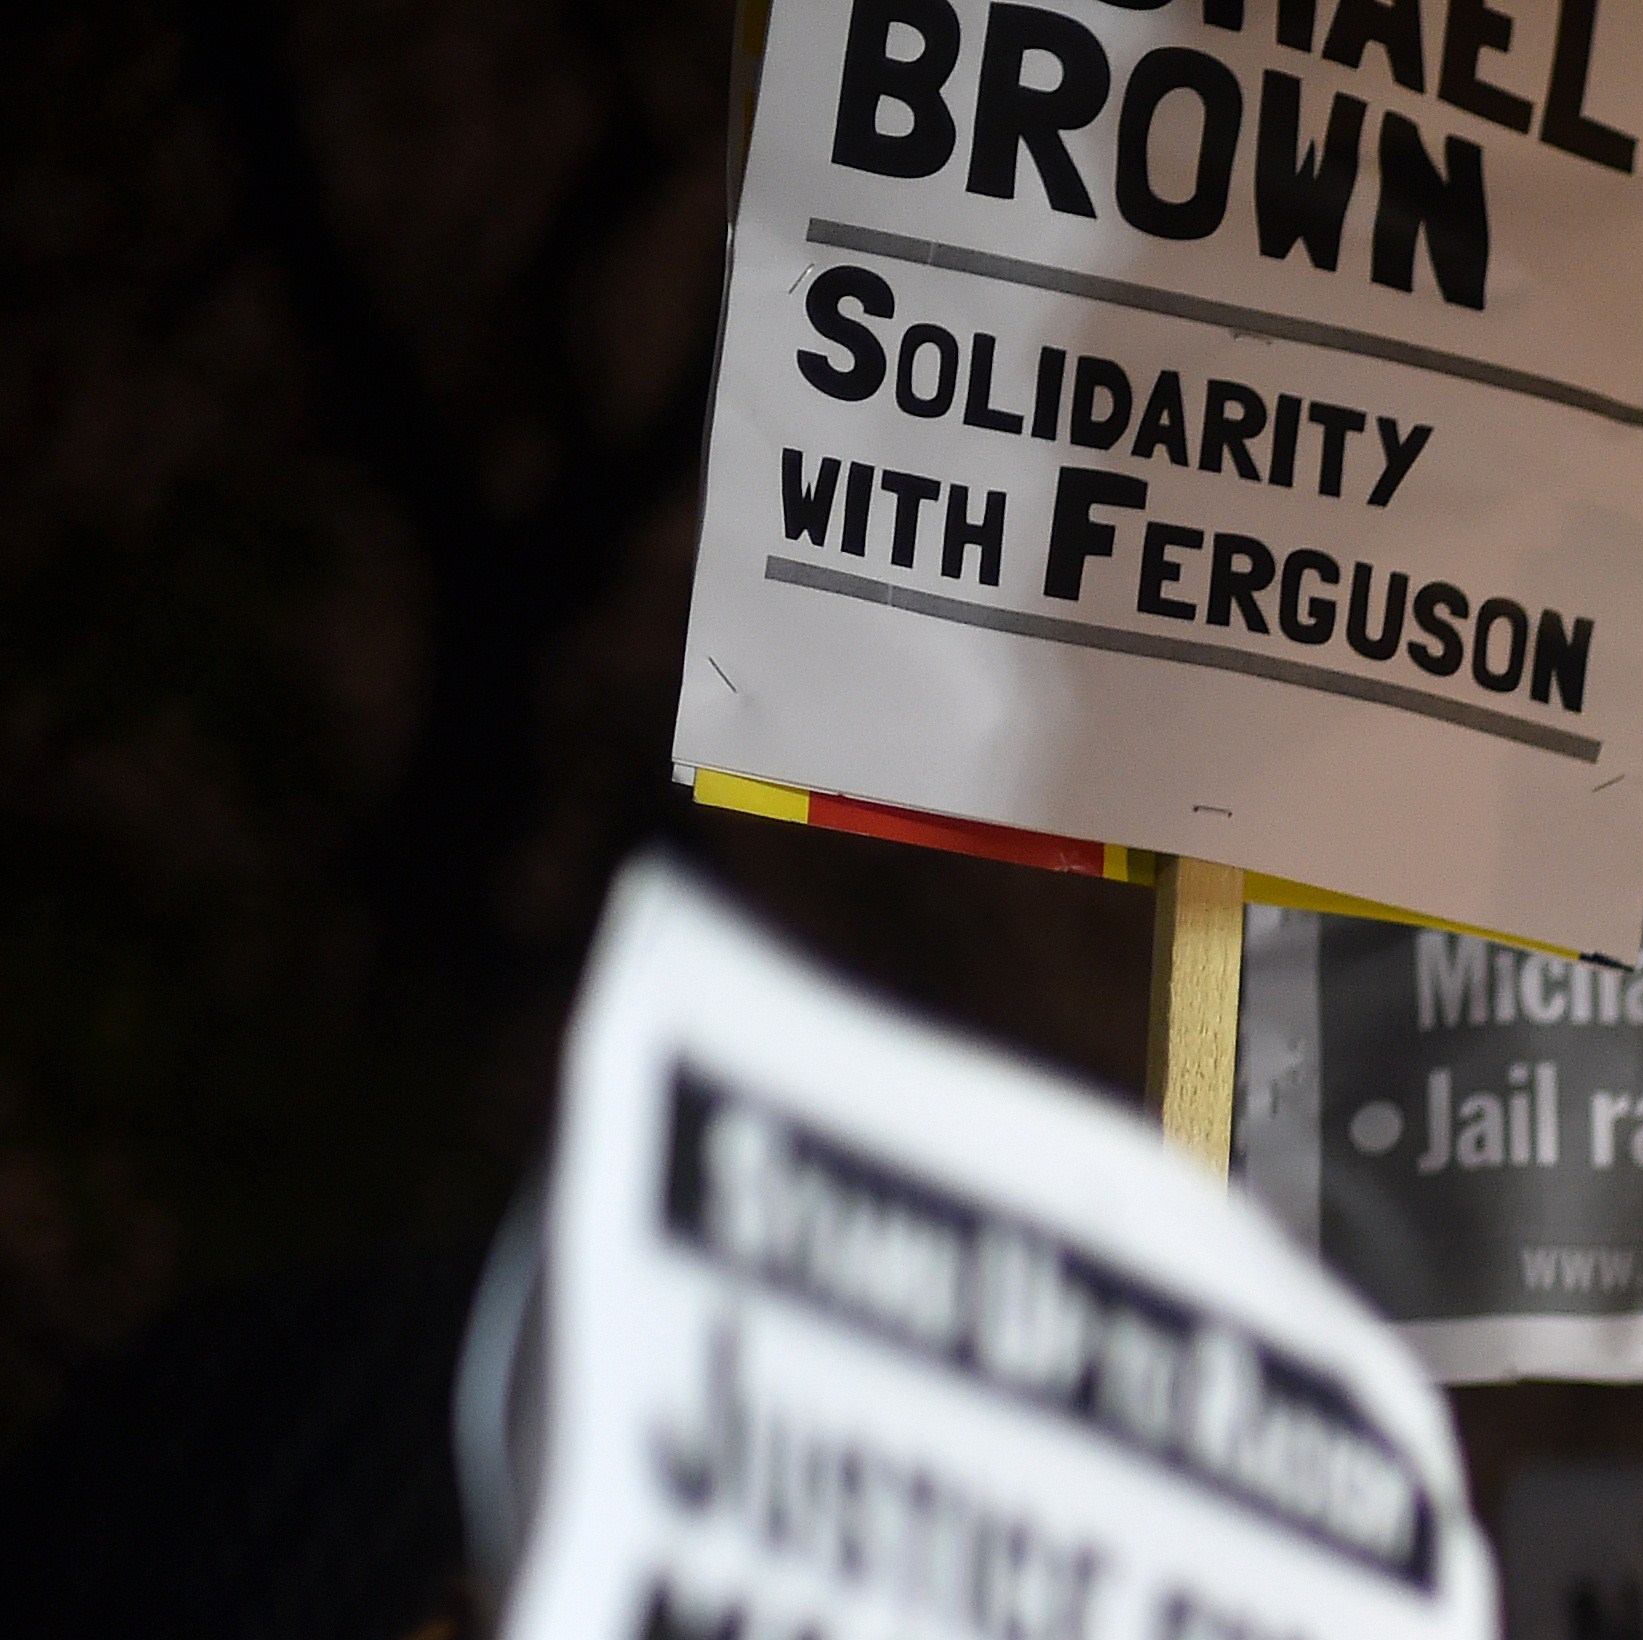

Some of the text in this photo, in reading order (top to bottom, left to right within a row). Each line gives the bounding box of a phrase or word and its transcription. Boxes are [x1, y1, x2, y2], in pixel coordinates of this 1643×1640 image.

[830, 0, 1491, 311] BROWN
[796, 264, 1434, 508] SOLIDARITY
[780, 446, 1597, 715] WITH FERGUSON
[1418, 1061, 1561, 1176] Jail
